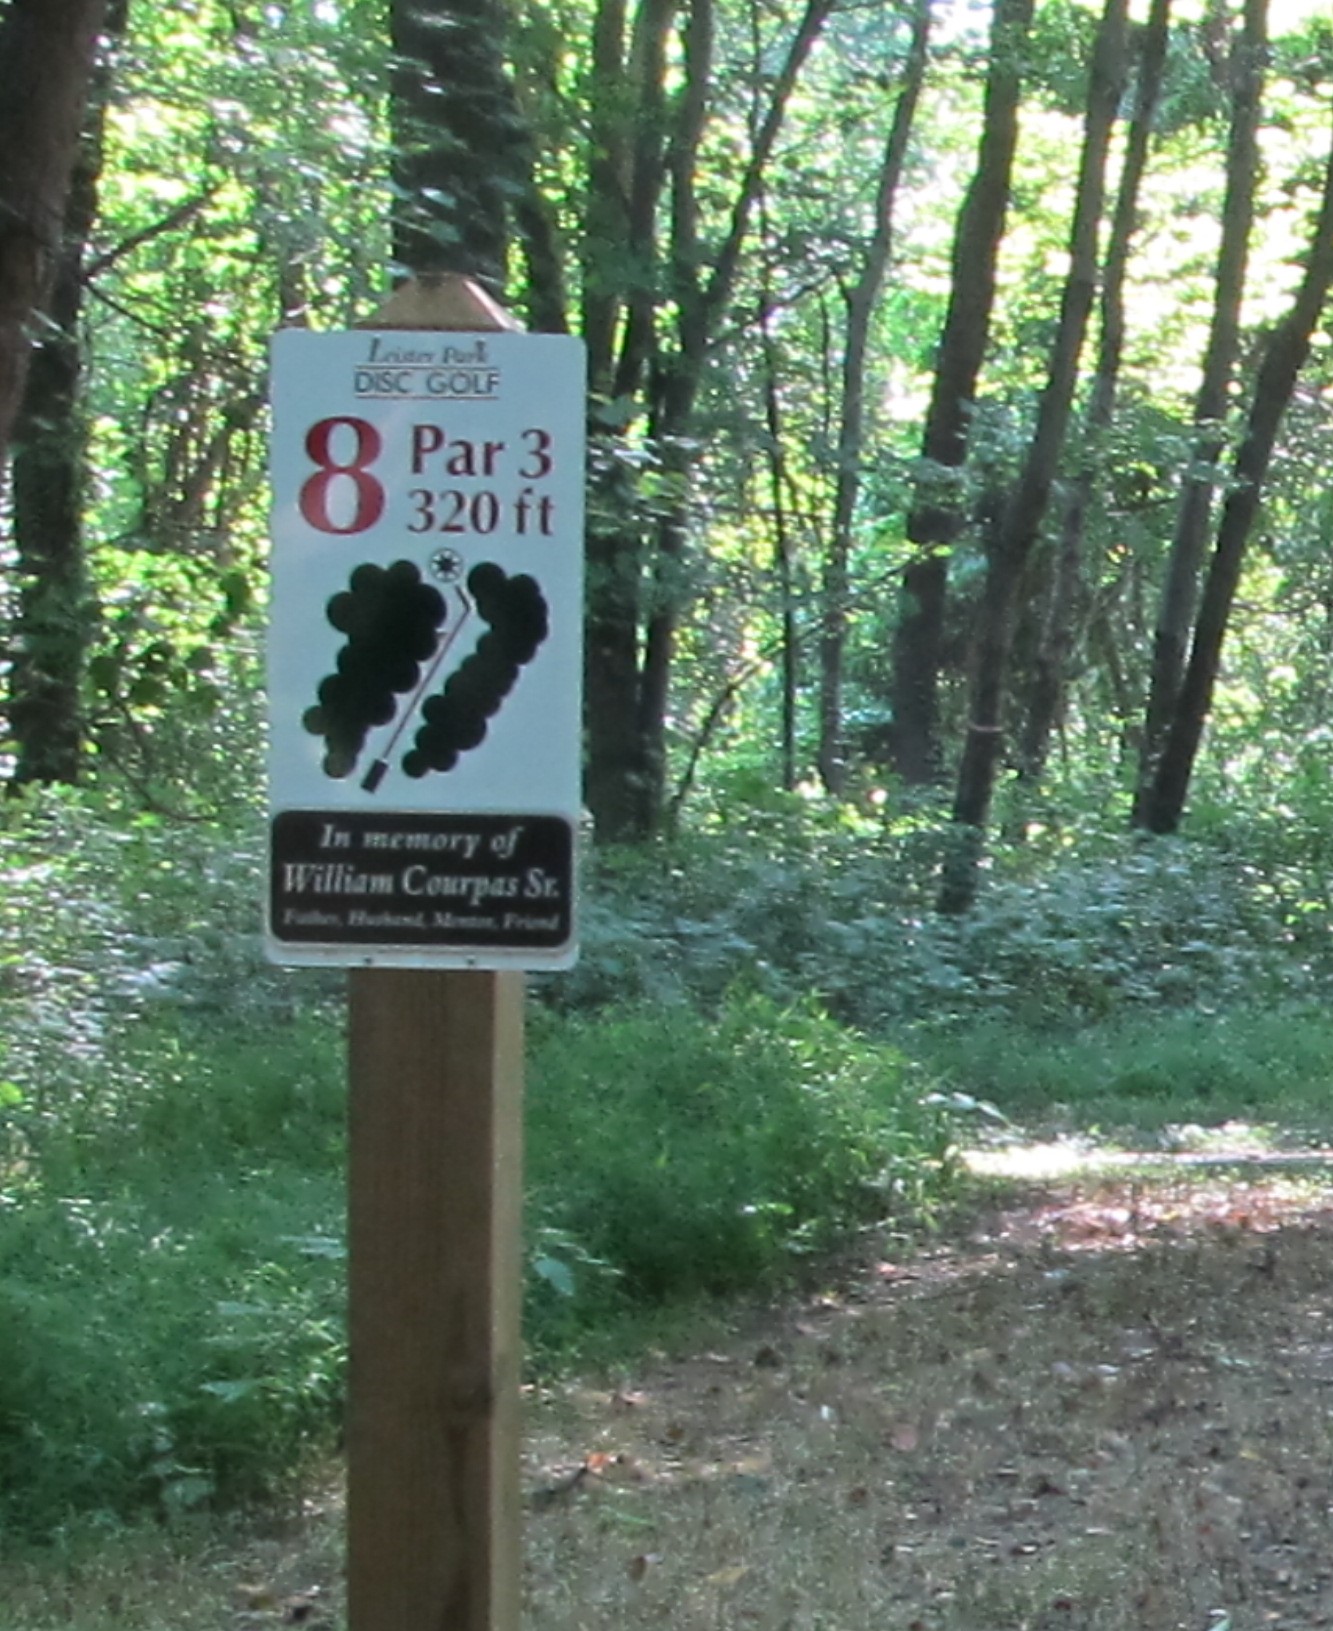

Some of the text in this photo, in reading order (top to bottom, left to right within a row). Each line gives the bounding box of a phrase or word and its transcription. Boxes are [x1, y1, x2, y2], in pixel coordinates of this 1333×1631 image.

[443, 340, 489, 364] Park
[355, 372, 500, 394] DISC GOLF
[411, 425, 552, 479] Par 3
[299, 416, 385, 535] 8
[407, 487, 554, 536] 320 ft
[320, 824, 524, 859] In memory of
[283, 863, 560, 905] William Courpas Sr.
